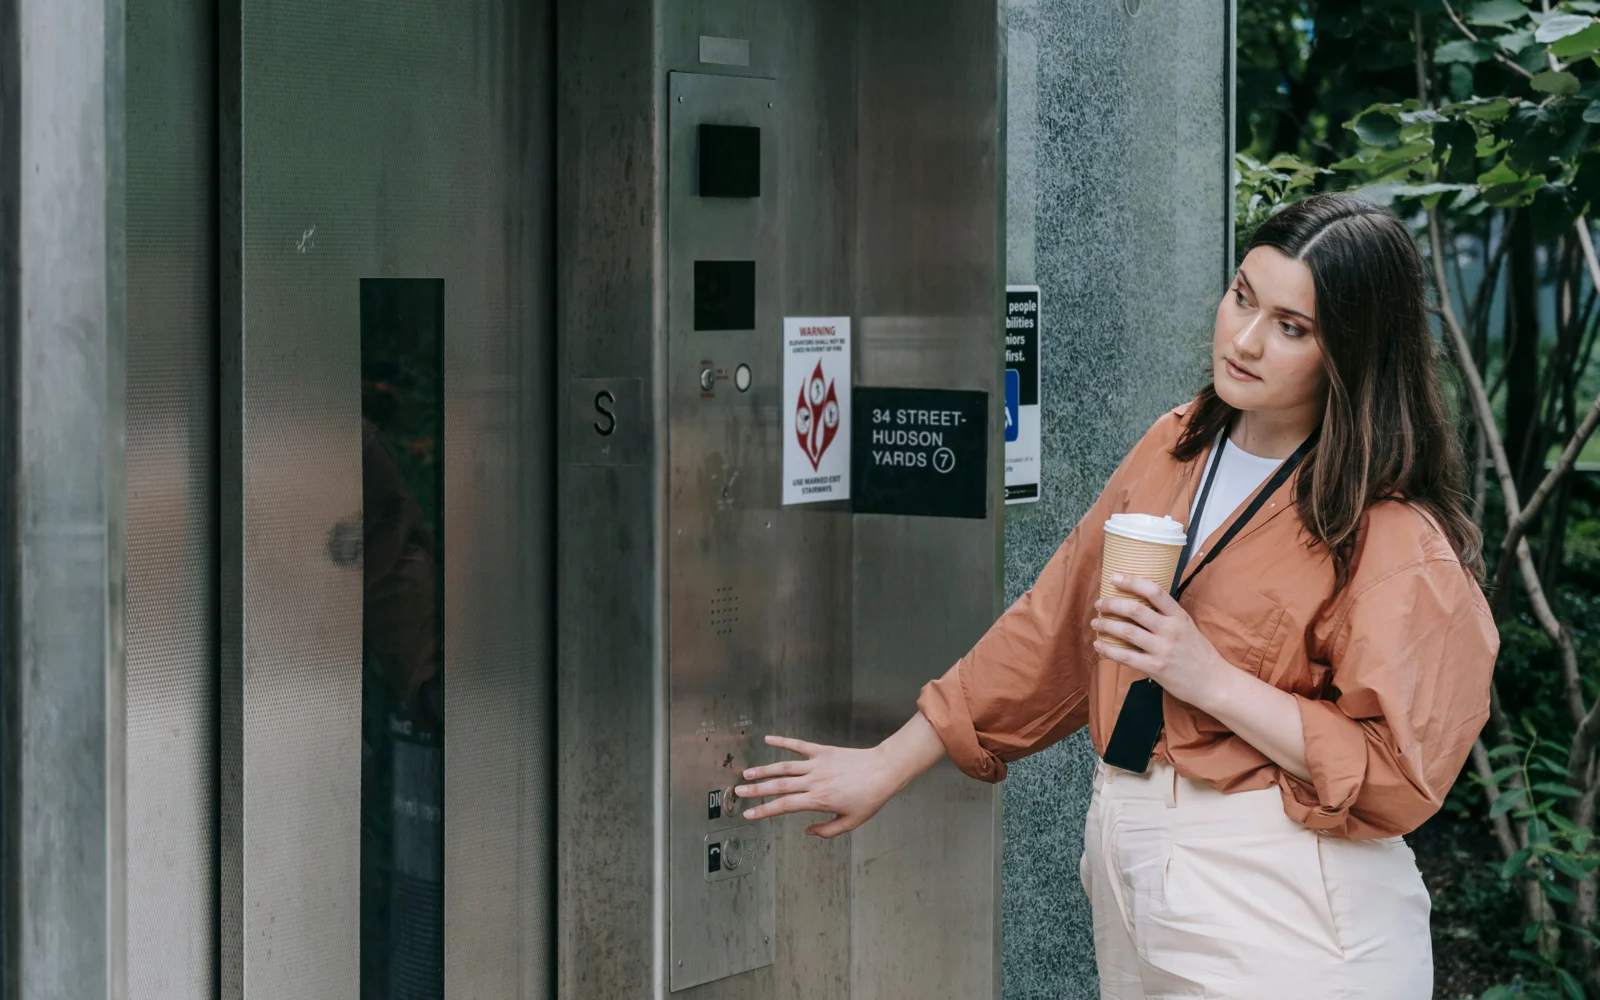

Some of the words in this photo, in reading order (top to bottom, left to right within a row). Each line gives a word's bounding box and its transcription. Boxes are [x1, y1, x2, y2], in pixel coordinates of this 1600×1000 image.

[1009, 300, 1036, 314] people
[799, 326, 836, 336] WARNING
[593, 390, 616, 437] S
[872, 408, 891, 424] 34
[896, 409, 967, 426] STREET-
[872, 430, 944, 447] HUDSON
[872, 450, 928, 468] YARDS
[792, 478, 803, 486] USE
[804, 476, 829, 485] MARKED
[829, 475, 841, 483] EXIT
[801, 485, 832, 495] STAIRWAYS
[709, 791, 721, 808] DN
